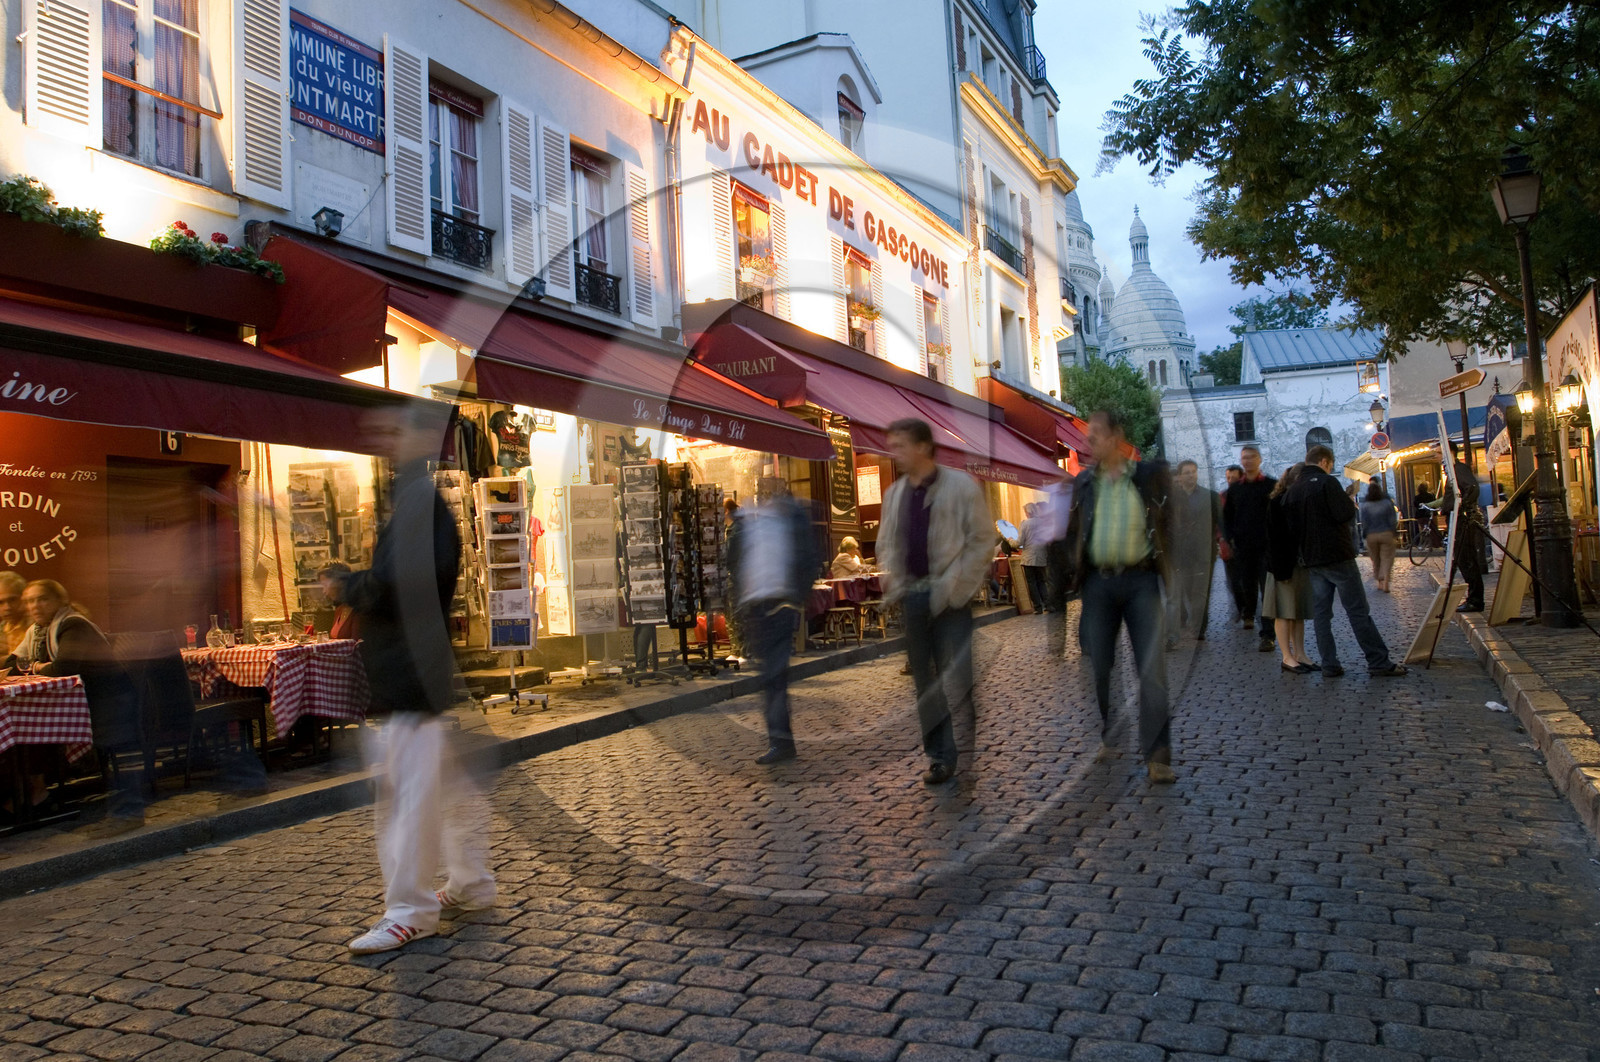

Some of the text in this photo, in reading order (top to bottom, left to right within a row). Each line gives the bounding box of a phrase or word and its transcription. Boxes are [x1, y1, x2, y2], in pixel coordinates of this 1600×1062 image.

[296, 55, 375, 106] du vieux
[299, 111, 374, 146] DON DUNLOP
[691, 98, 950, 289] AU CADET DE GASCOGNE
[0, 371, 78, 405] ine
[632, 398, 650, 420] Le
[728, 419, 746, 440] Lit
[167, 431, 178, 451] 6
[0, 463, 98, 482] Fondée en 1793
[0, 491, 61, 518] RDIN
[9, 520, 25, 532] et
[0, 525, 77, 567] QUETS
